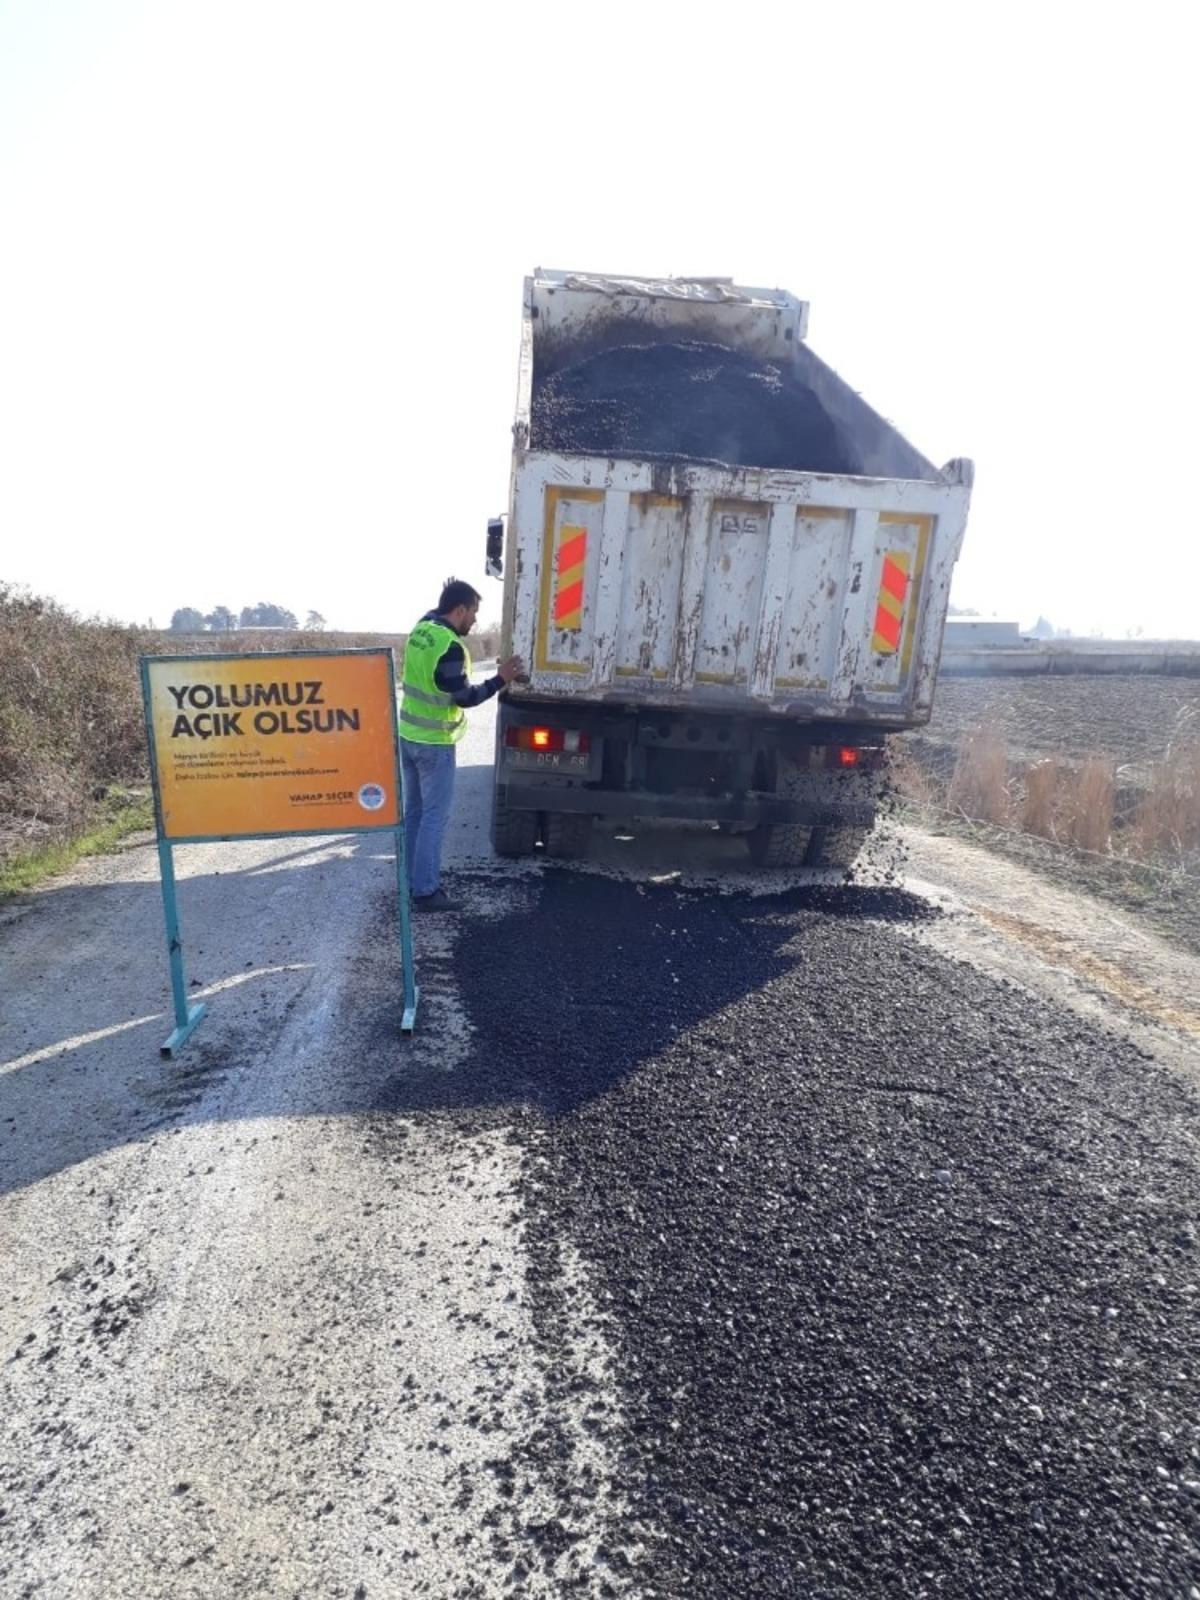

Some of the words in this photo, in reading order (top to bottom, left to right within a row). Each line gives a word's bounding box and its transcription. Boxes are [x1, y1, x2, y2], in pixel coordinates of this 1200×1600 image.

[168, 681, 325, 709] YOLUMUZ
[171, 712, 244, 740] AÇIK
[254, 709, 360, 735] OLSUN
[289, 793, 323, 803] VAHAP
